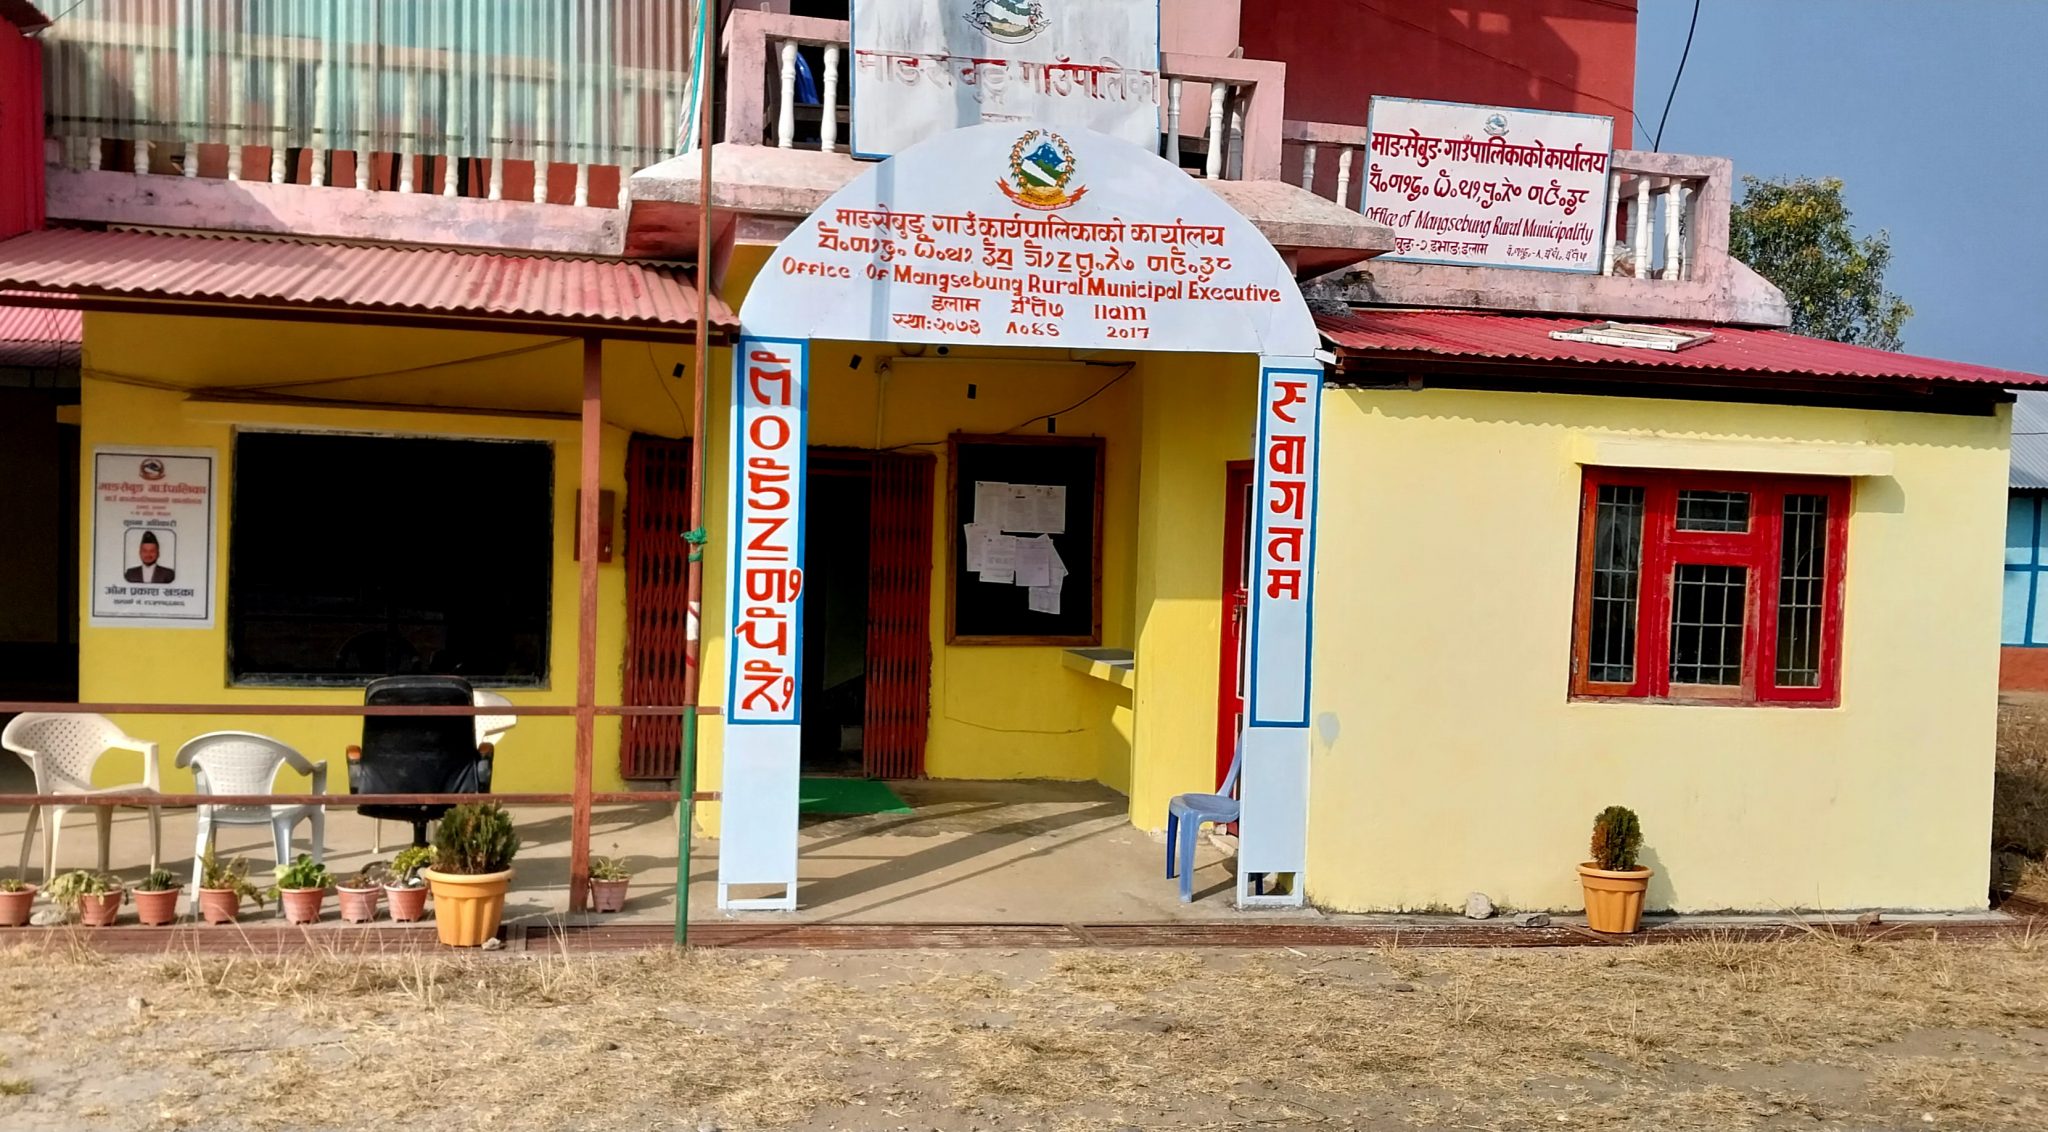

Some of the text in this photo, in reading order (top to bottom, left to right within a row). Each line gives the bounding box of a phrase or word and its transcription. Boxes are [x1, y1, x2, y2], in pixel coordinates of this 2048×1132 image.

[1544, 143, 1608, 174] कार्यालय
[1131, 217, 1226, 248] कार्यालय
[1365, 206, 1398, 227] Office
[1400, 210, 1416, 228] of
[1415, 211, 1491, 238] Mangsebung
[1522, 218, 1594, 246] Municipality
[782, 256, 1281, 302] Office Of Mangsebung Rural Municipal Executive
[1107, 326, 1149, 339] 2017
